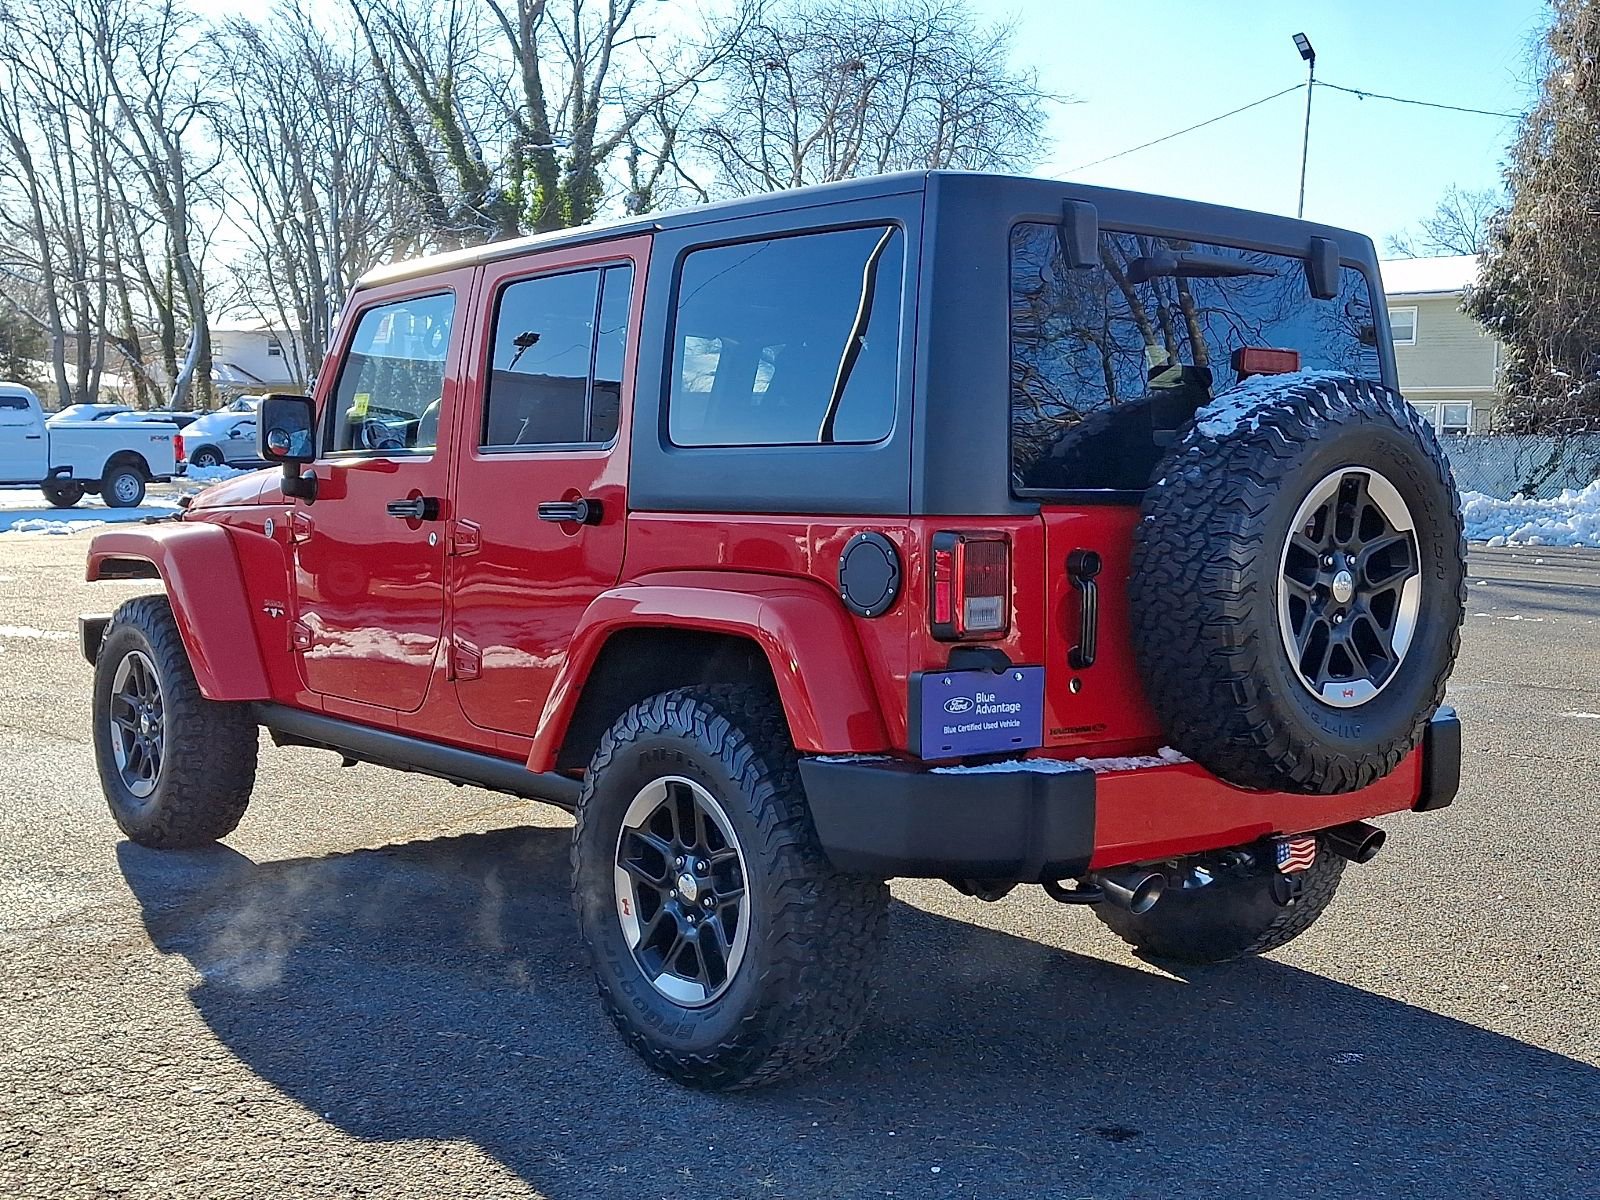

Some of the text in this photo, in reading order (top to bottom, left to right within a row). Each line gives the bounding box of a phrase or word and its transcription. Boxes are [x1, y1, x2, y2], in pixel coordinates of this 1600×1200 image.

[975, 692, 996, 703] Blue
[947, 698, 970, 712] Ford
[975, 702, 1021, 715] Advantage
[943, 719, 1021, 735] Blue Certified Used Vehicle
[596, 905, 697, 1040] BFGoodric
